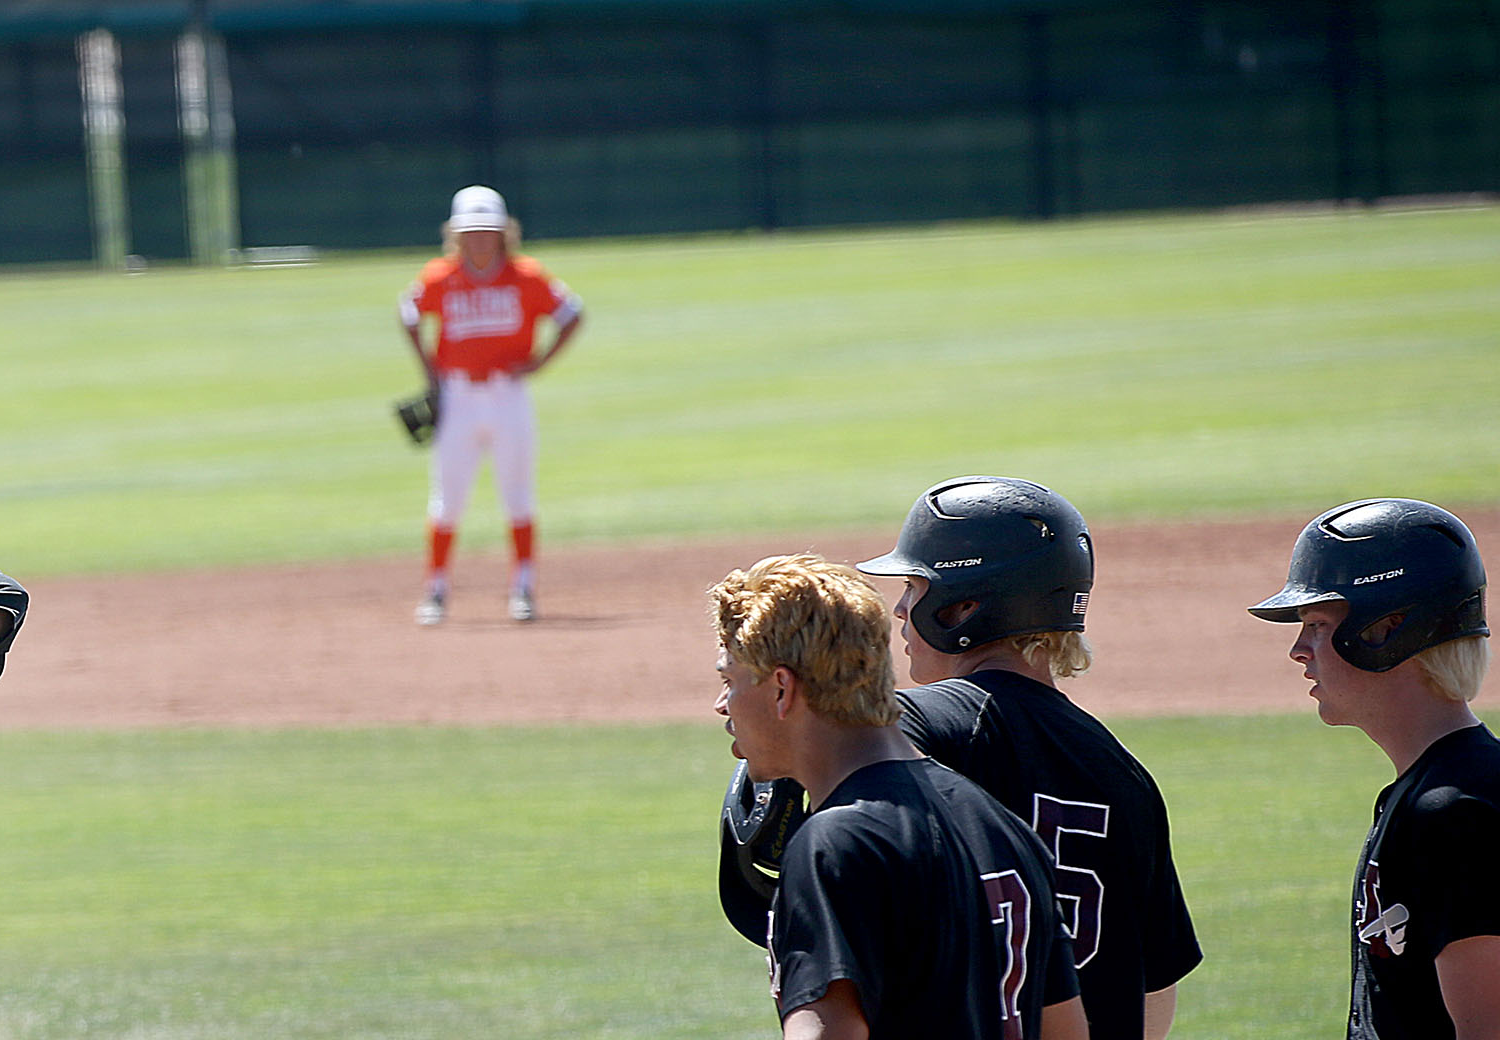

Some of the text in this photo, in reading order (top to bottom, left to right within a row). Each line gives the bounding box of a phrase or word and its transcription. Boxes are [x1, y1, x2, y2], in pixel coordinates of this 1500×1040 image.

[934, 557, 982, 569] EASTON
[1352, 568, 1403, 585] EASTON
[1032, 792, 1110, 970] 5
